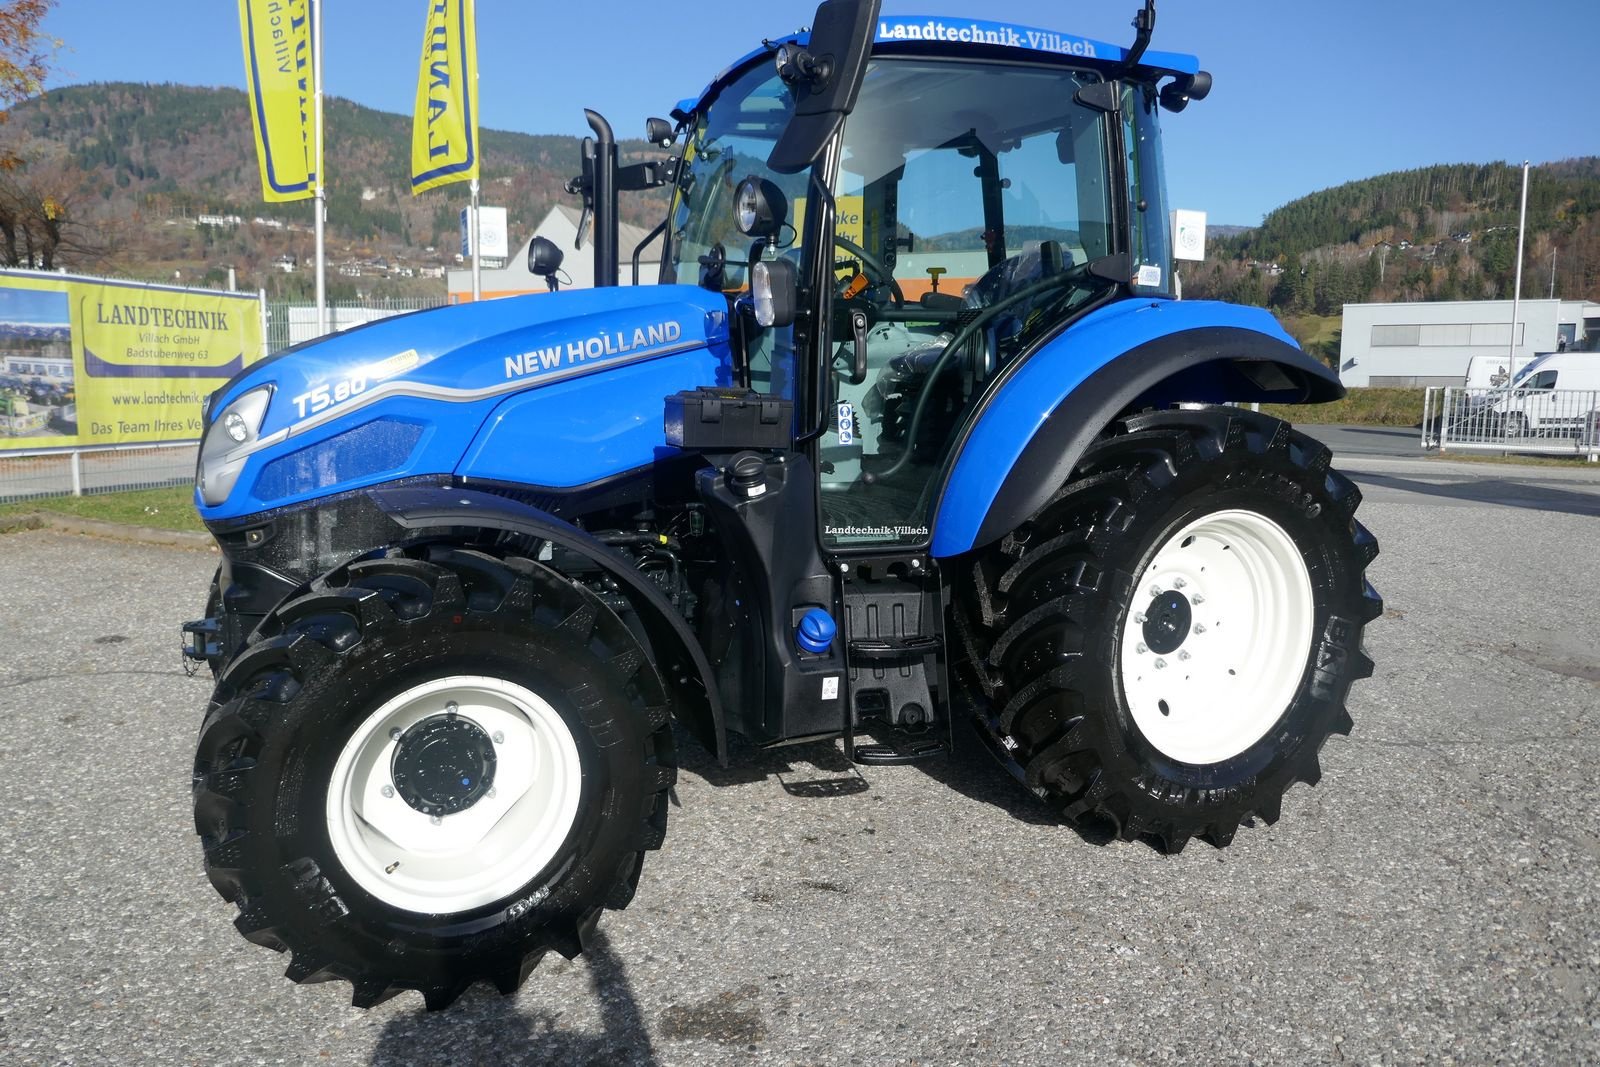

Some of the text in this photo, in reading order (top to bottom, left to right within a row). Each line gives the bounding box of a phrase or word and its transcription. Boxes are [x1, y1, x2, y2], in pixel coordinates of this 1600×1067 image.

[879, 22, 1097, 58] Landtechnik-Villach
[97, 303, 229, 331] LANDTECHNIK
[139, 333, 200, 345] Villach GmbH
[126, 348, 209, 362] Badstubenweg 63
[504, 320, 681, 378] NEW HOLLAND
[112, 391, 204, 405] www.landtechnik.
[292, 374, 368, 419] T5.80
[91, 422, 113, 435] Das
[117, 421, 150, 434] Team
[154, 419, 183, 432] Ihres
[824, 525, 929, 535] Landtechnik-Villach
